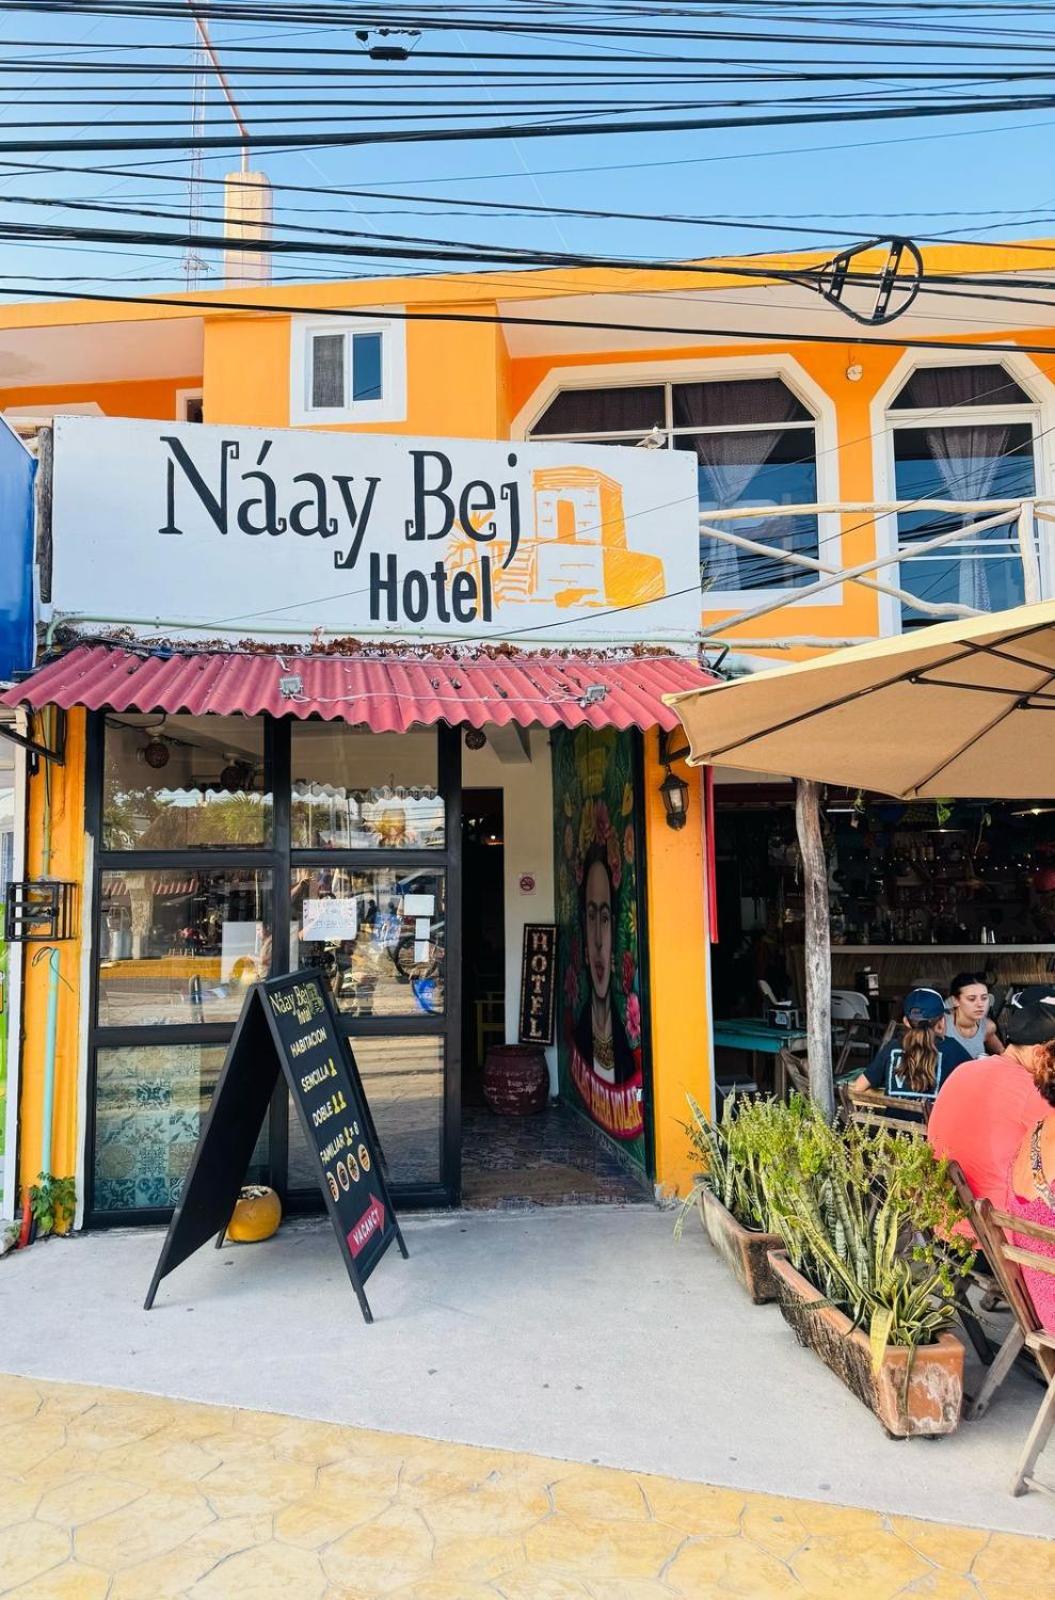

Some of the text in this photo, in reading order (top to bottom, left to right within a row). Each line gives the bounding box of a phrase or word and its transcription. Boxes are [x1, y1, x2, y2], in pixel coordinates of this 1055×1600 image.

[159, 436, 521, 569] Náay Bej
[369, 552, 493, 623] Hotel
[529, 932, 548, 1038] HOTEL
[301, 1063, 330, 1093] SENCILLA
[312, 1101, 333, 1127] DOBLE
[320, 1133, 346, 1167] FAMILIAR
[352, 1207, 381, 1247] VACANCY
